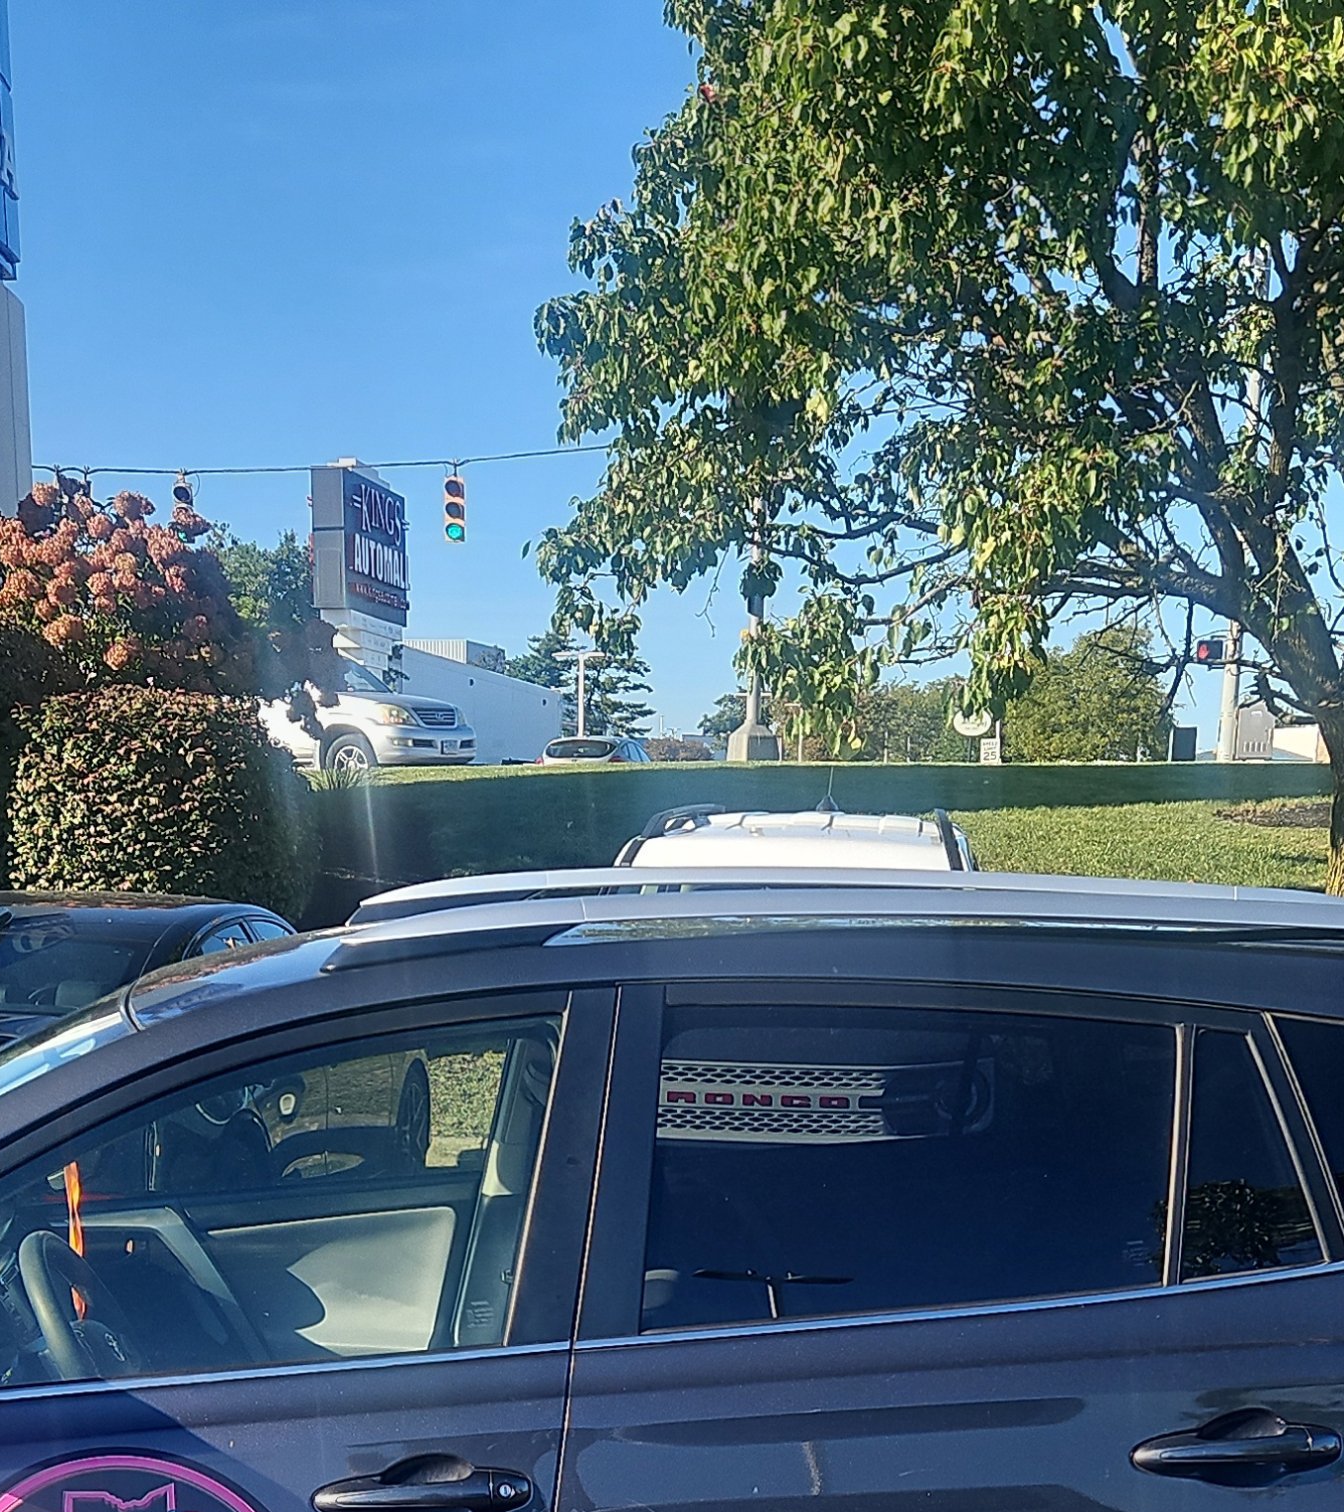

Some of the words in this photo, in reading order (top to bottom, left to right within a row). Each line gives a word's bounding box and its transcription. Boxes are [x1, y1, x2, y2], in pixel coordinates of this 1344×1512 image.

[360, 483, 402, 546] KINGS
[354, 532, 410, 590] AUTOMALL
[983, 751, 997, 761] 25
[666, 1091, 850, 1109] RONCO
